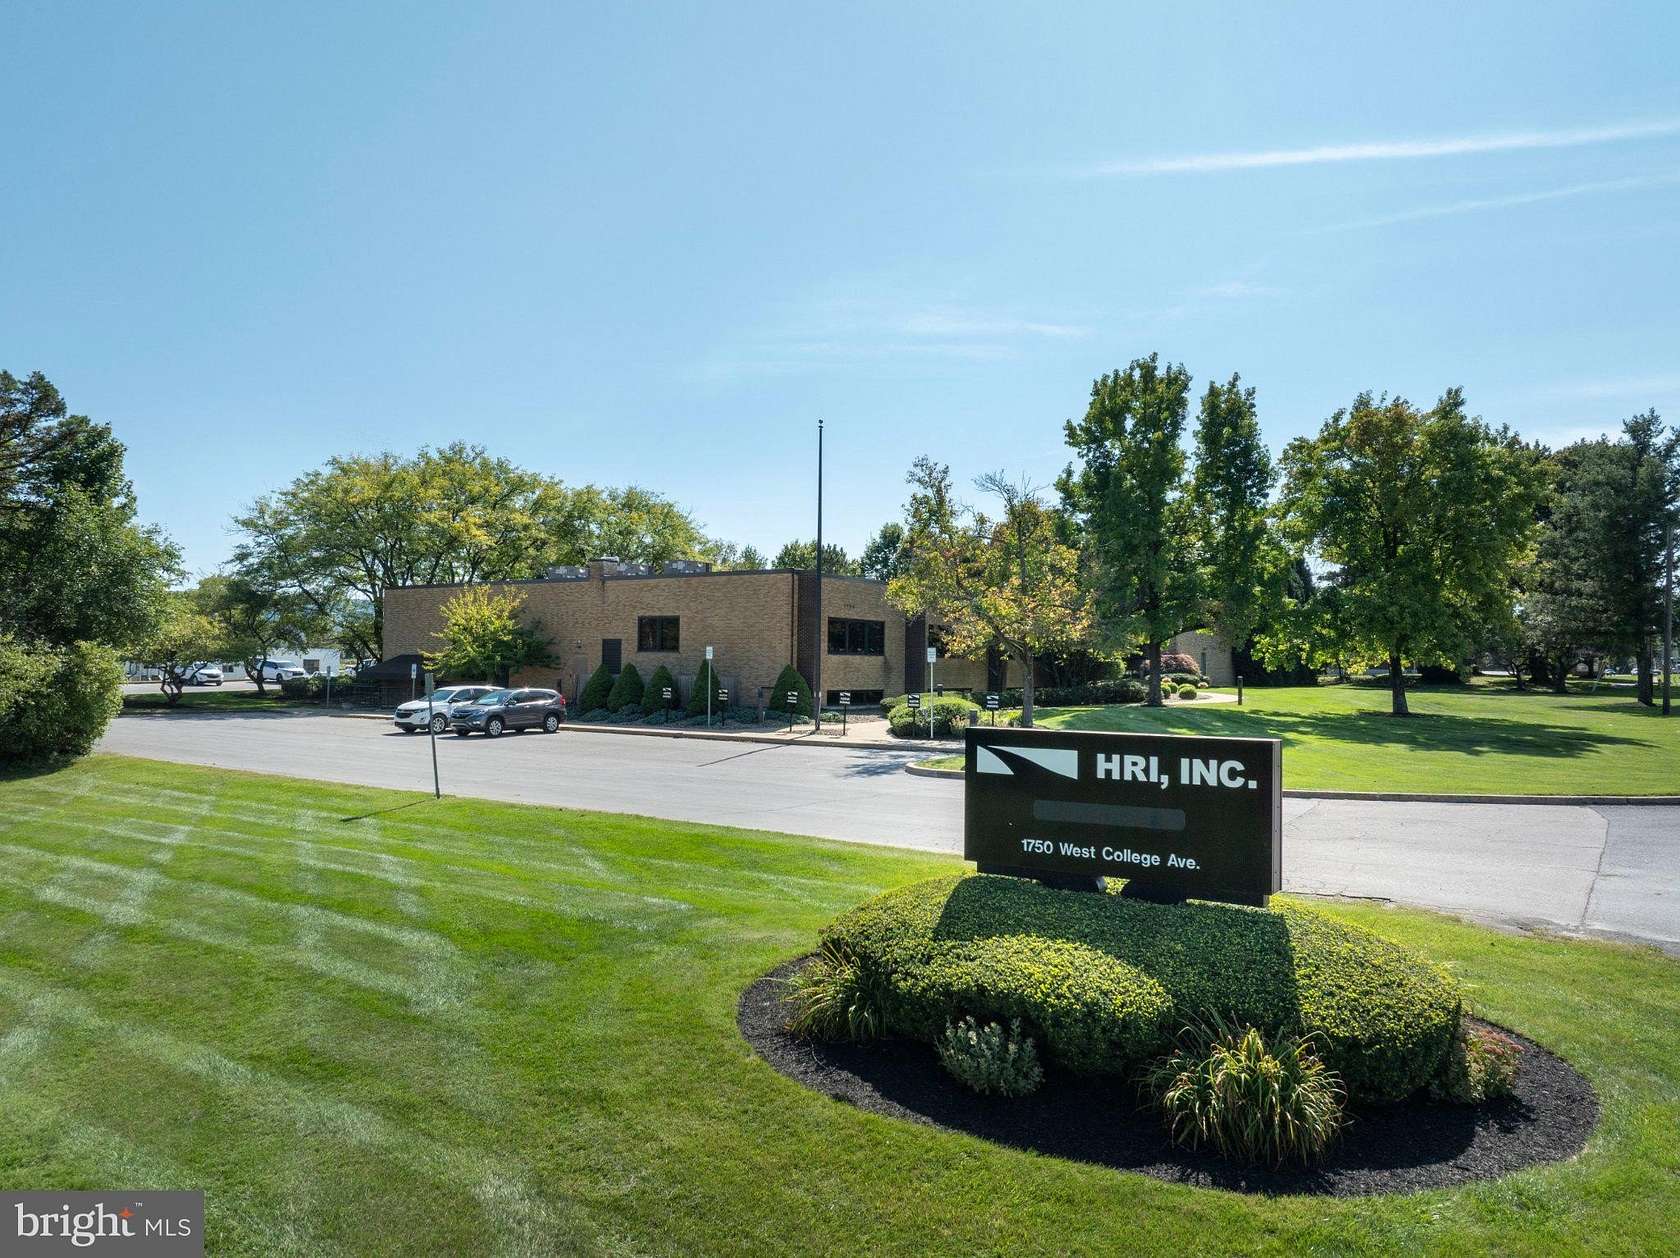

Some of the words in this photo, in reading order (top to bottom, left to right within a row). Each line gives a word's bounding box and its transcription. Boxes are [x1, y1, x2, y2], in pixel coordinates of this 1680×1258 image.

[1096, 753, 1169, 790] HRI,
[1180, 757, 1258, 789] INC.
[1021, 838, 1054, 855] 1750
[1059, 842, 1096, 860] West
[1102, 846, 1161, 868] College
[1167, 853, 1200, 870] Ave.
